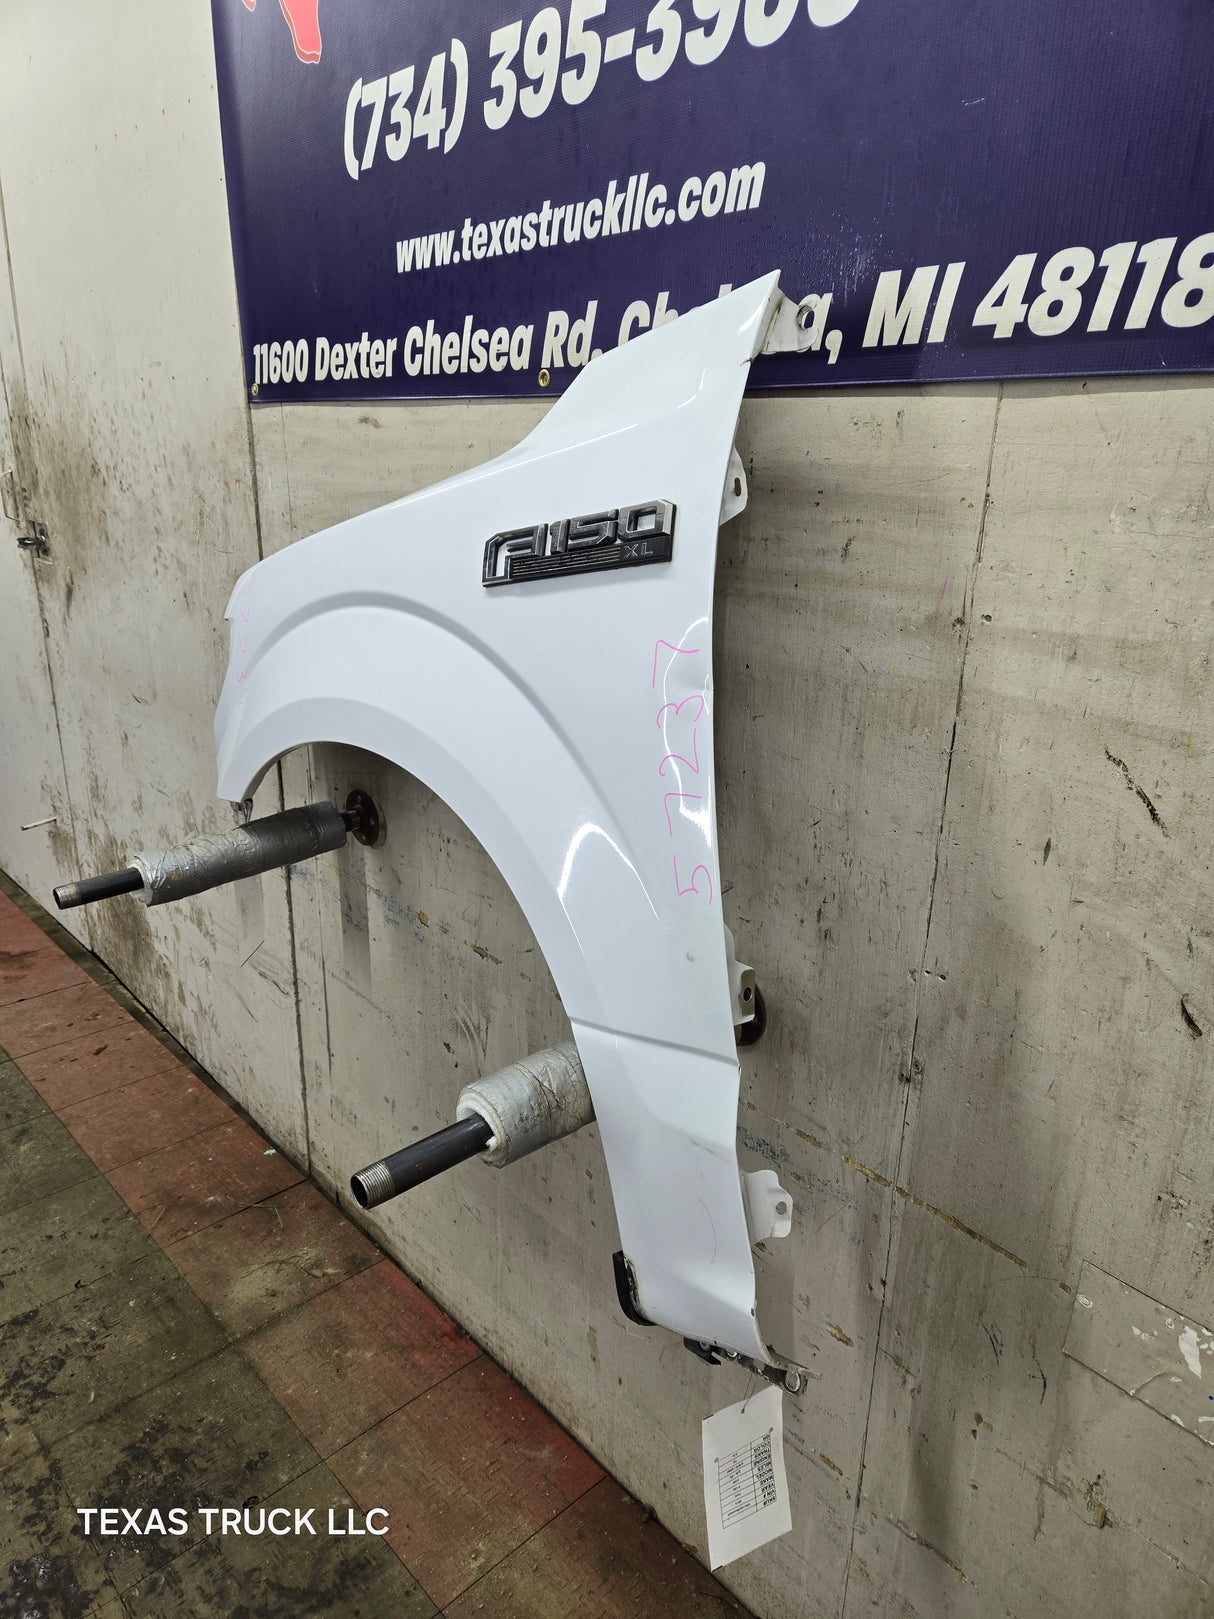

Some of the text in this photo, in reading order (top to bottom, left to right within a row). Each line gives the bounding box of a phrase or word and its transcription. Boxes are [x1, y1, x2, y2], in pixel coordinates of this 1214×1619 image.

[344, 38, 468, 180] (734)
[396, 161, 766, 273] www.texastruckllc.com
[253, 338, 309, 385] 11600
[315, 332, 397, 381] Dexter
[404, 315, 534, 377] Chelsea
[862, 261, 966, 348] MI
[972, 232, 1214, 338] 48118
[624, 542, 654, 559] XL
